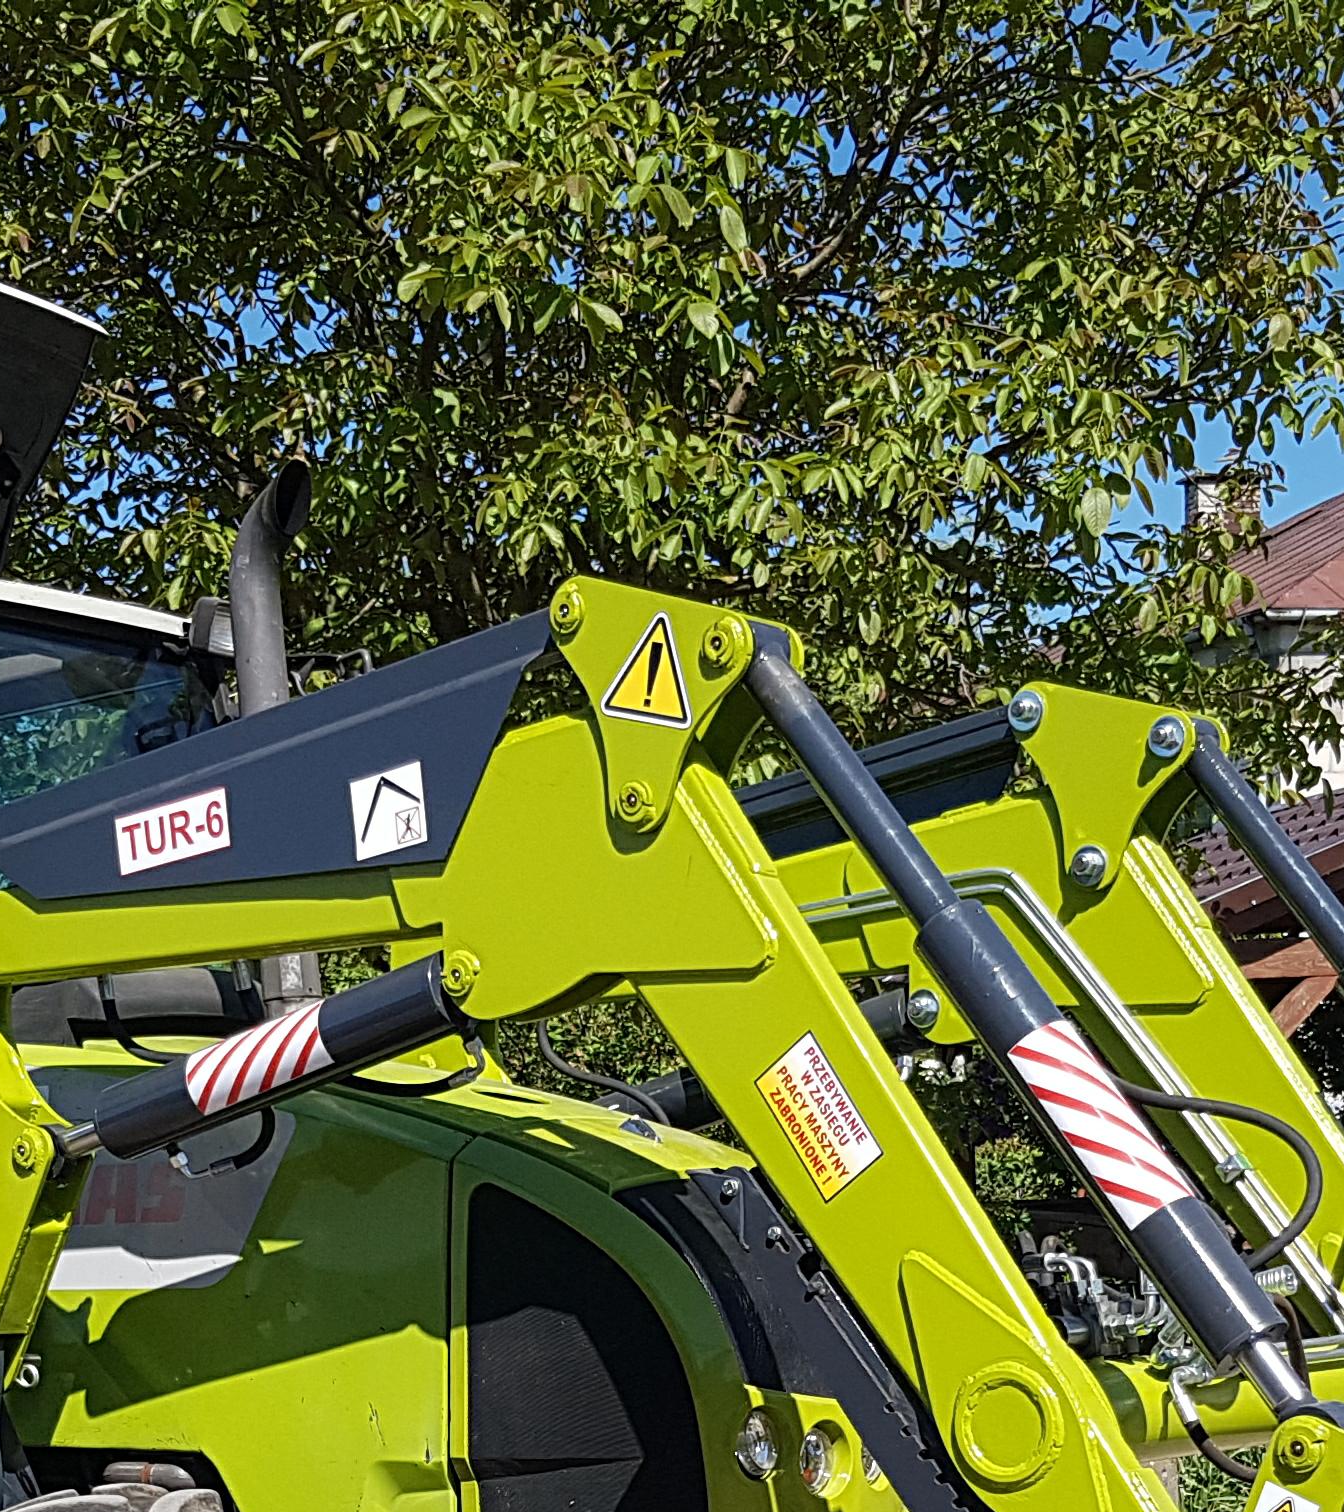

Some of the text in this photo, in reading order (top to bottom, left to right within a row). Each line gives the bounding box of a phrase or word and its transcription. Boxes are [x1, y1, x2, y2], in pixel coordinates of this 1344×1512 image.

[122, 801, 224, 860] TUR-6
[769, 1087, 827, 1177] ZABRONIONE
[776, 1065, 850, 1179] PRACY MASZYNY
[801, 1070, 850, 1147] W ZASIĘGU
[804, 1046, 867, 1145] PRZEBYWANIE
